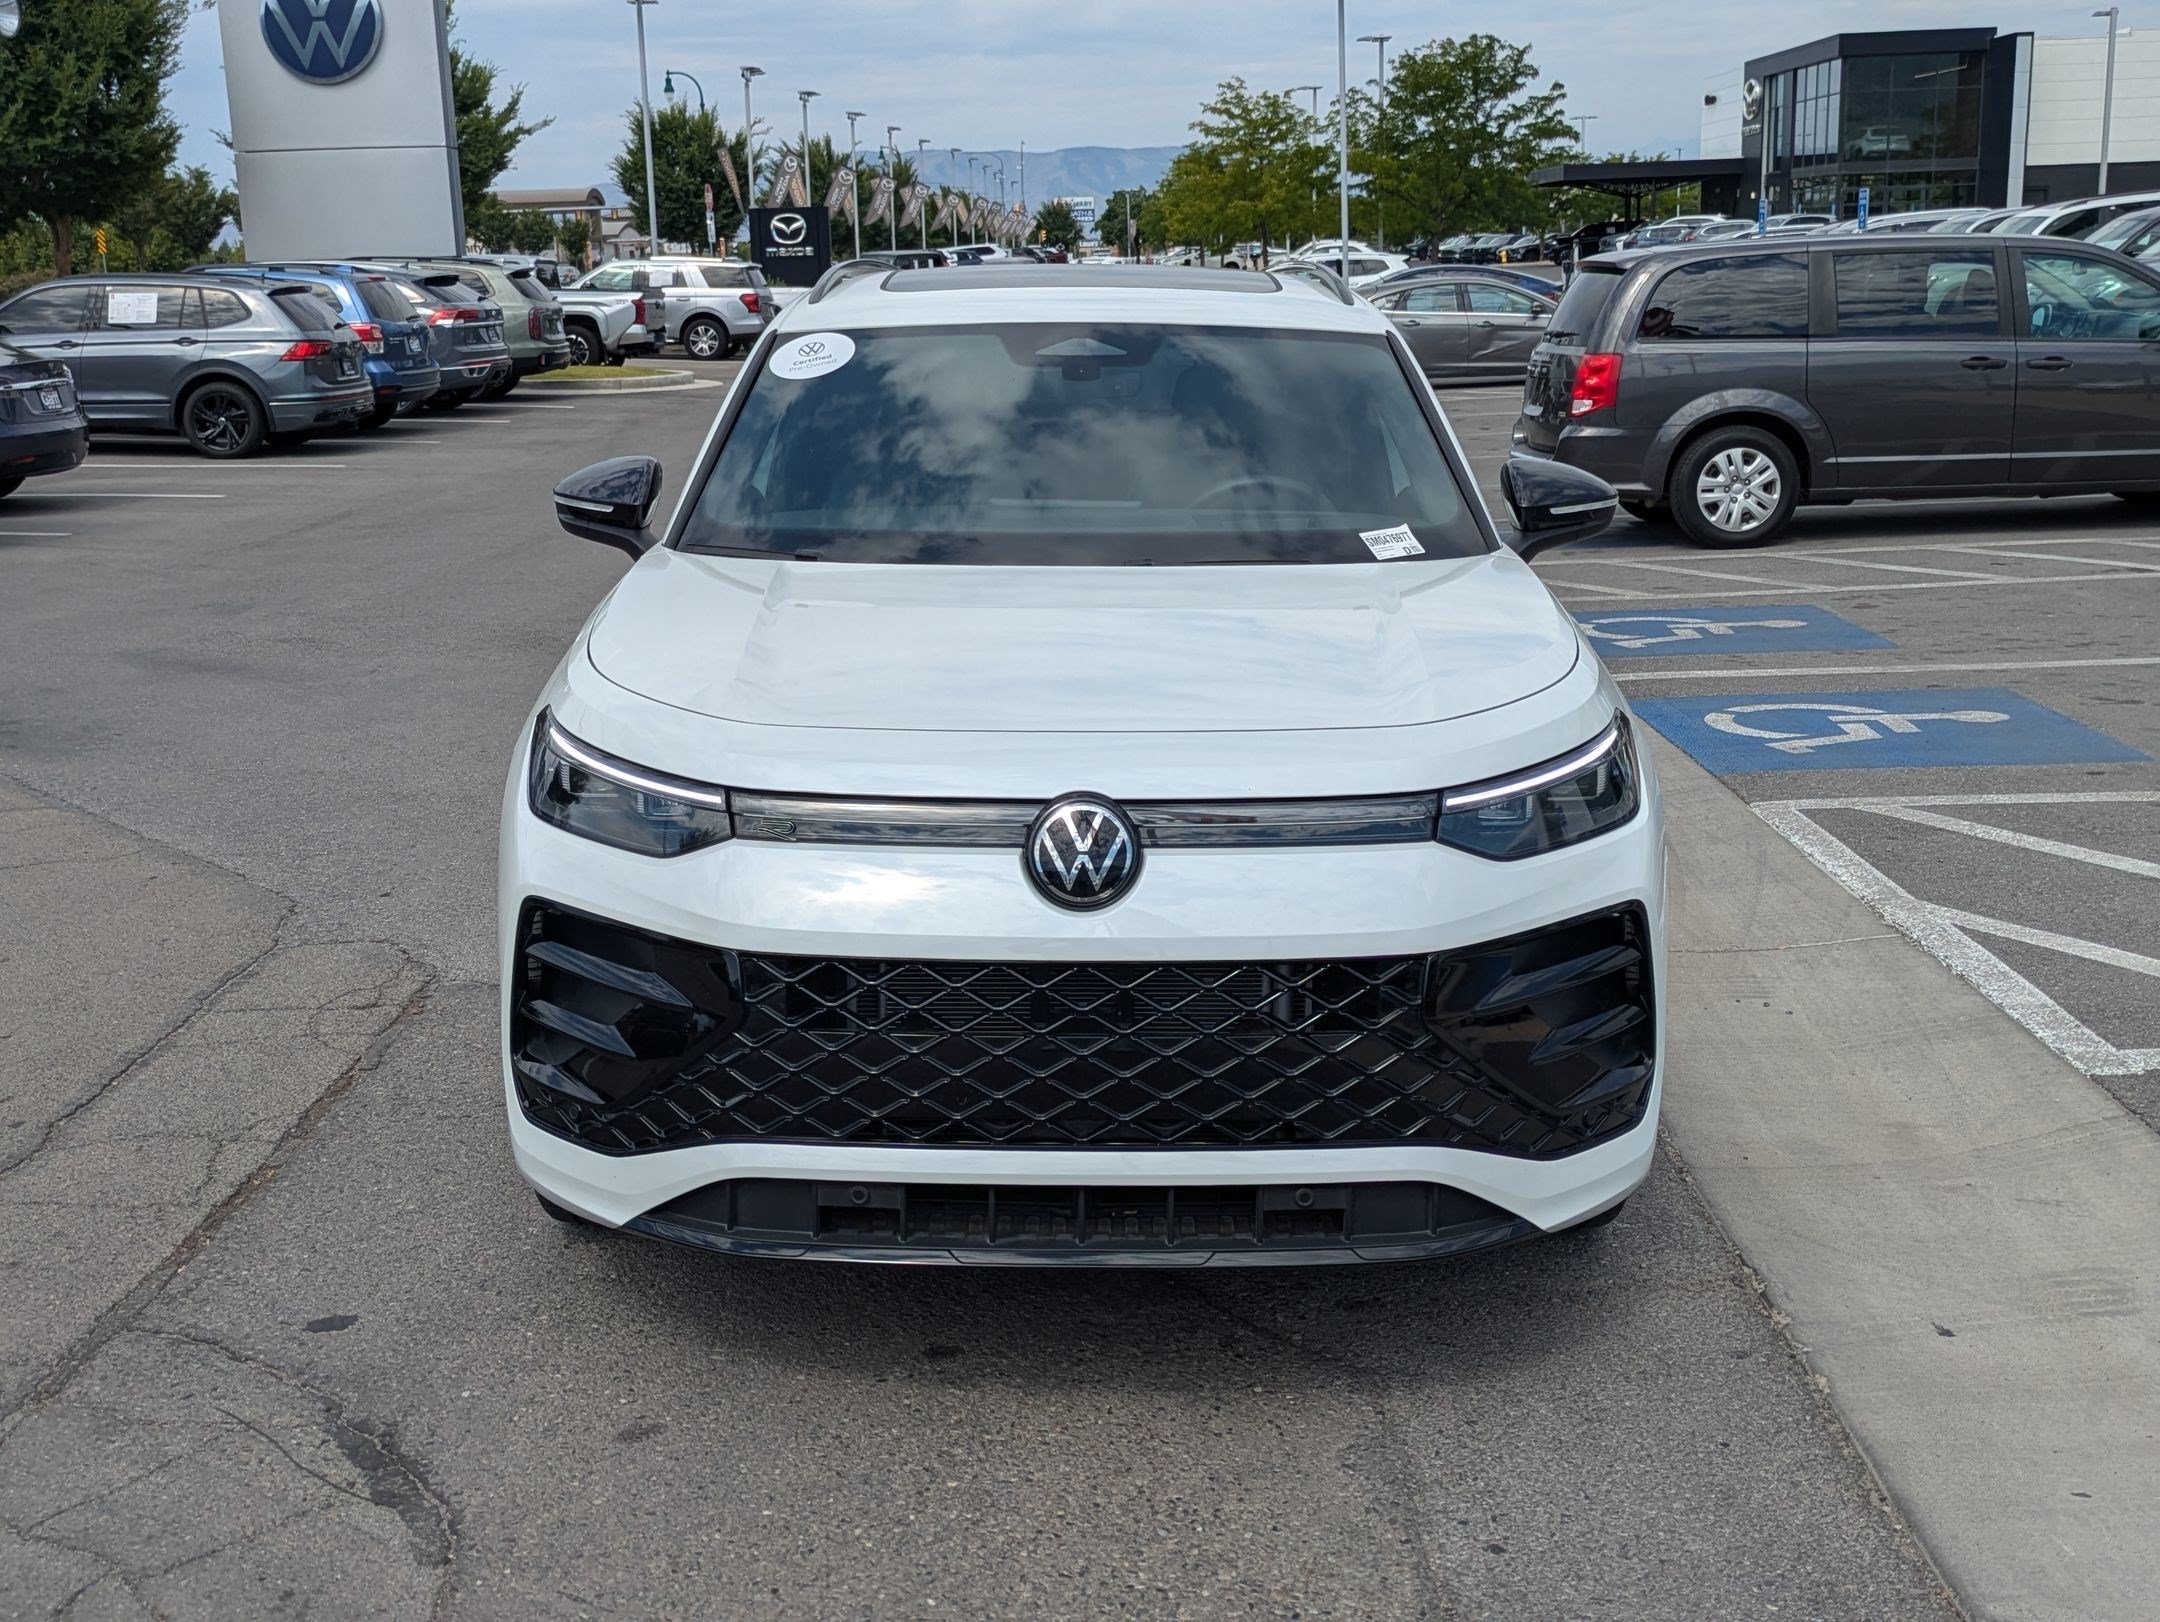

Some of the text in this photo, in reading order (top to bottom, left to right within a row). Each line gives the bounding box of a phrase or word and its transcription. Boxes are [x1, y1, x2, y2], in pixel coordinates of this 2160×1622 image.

[765, 247, 815, 257] mazda
[788, 358, 838, 373] Pre-Owned
[793, 353, 832, 366] Certified
